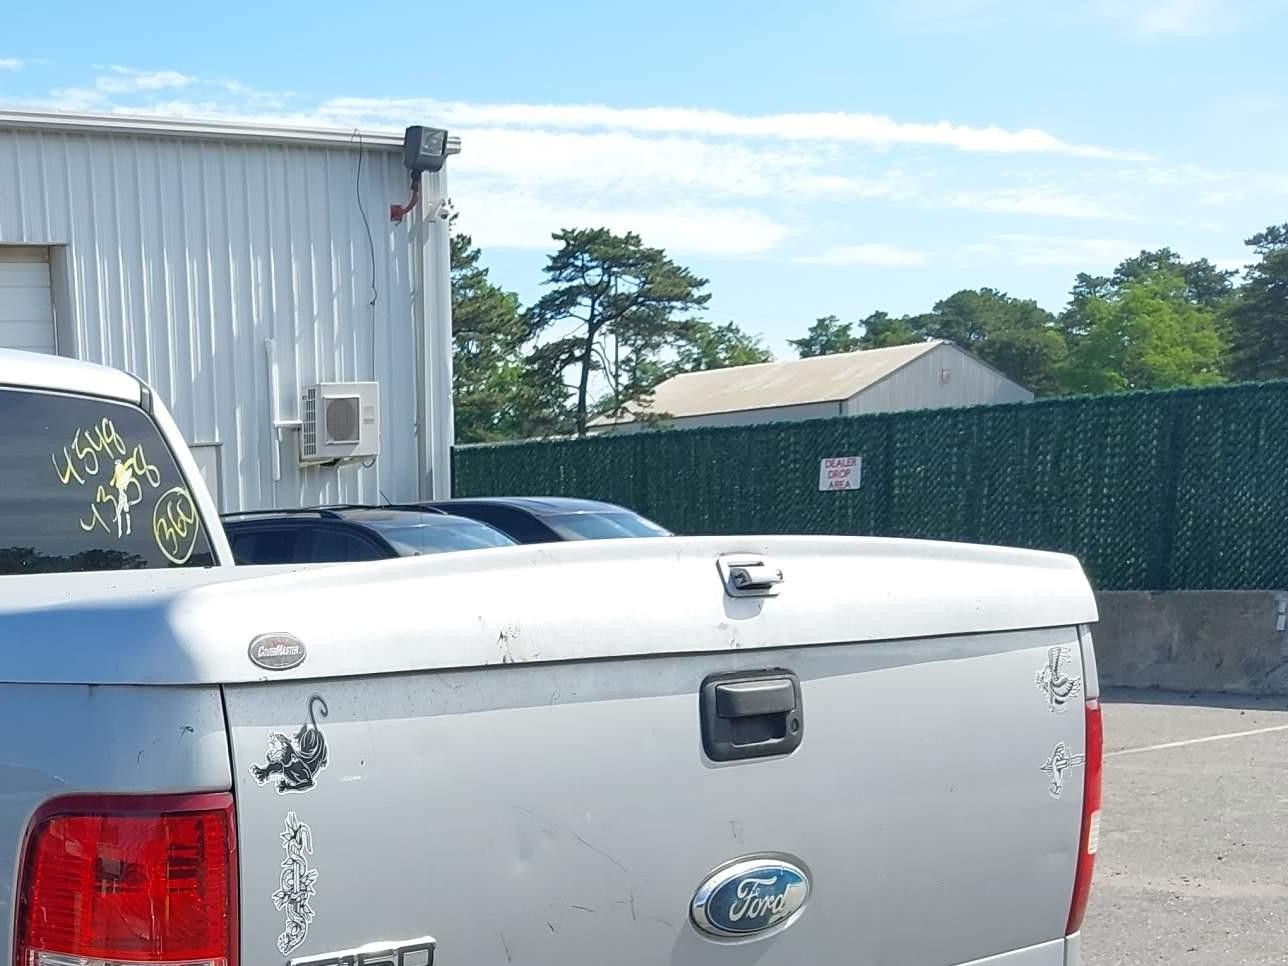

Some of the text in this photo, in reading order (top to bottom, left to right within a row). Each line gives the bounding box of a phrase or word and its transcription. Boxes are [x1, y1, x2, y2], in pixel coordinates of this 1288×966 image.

[52, 417, 127, 485] 4548
[824, 457, 857, 469] DEALER
[828, 469, 851, 479] DROP
[728, 876, 791, 922] Ford
